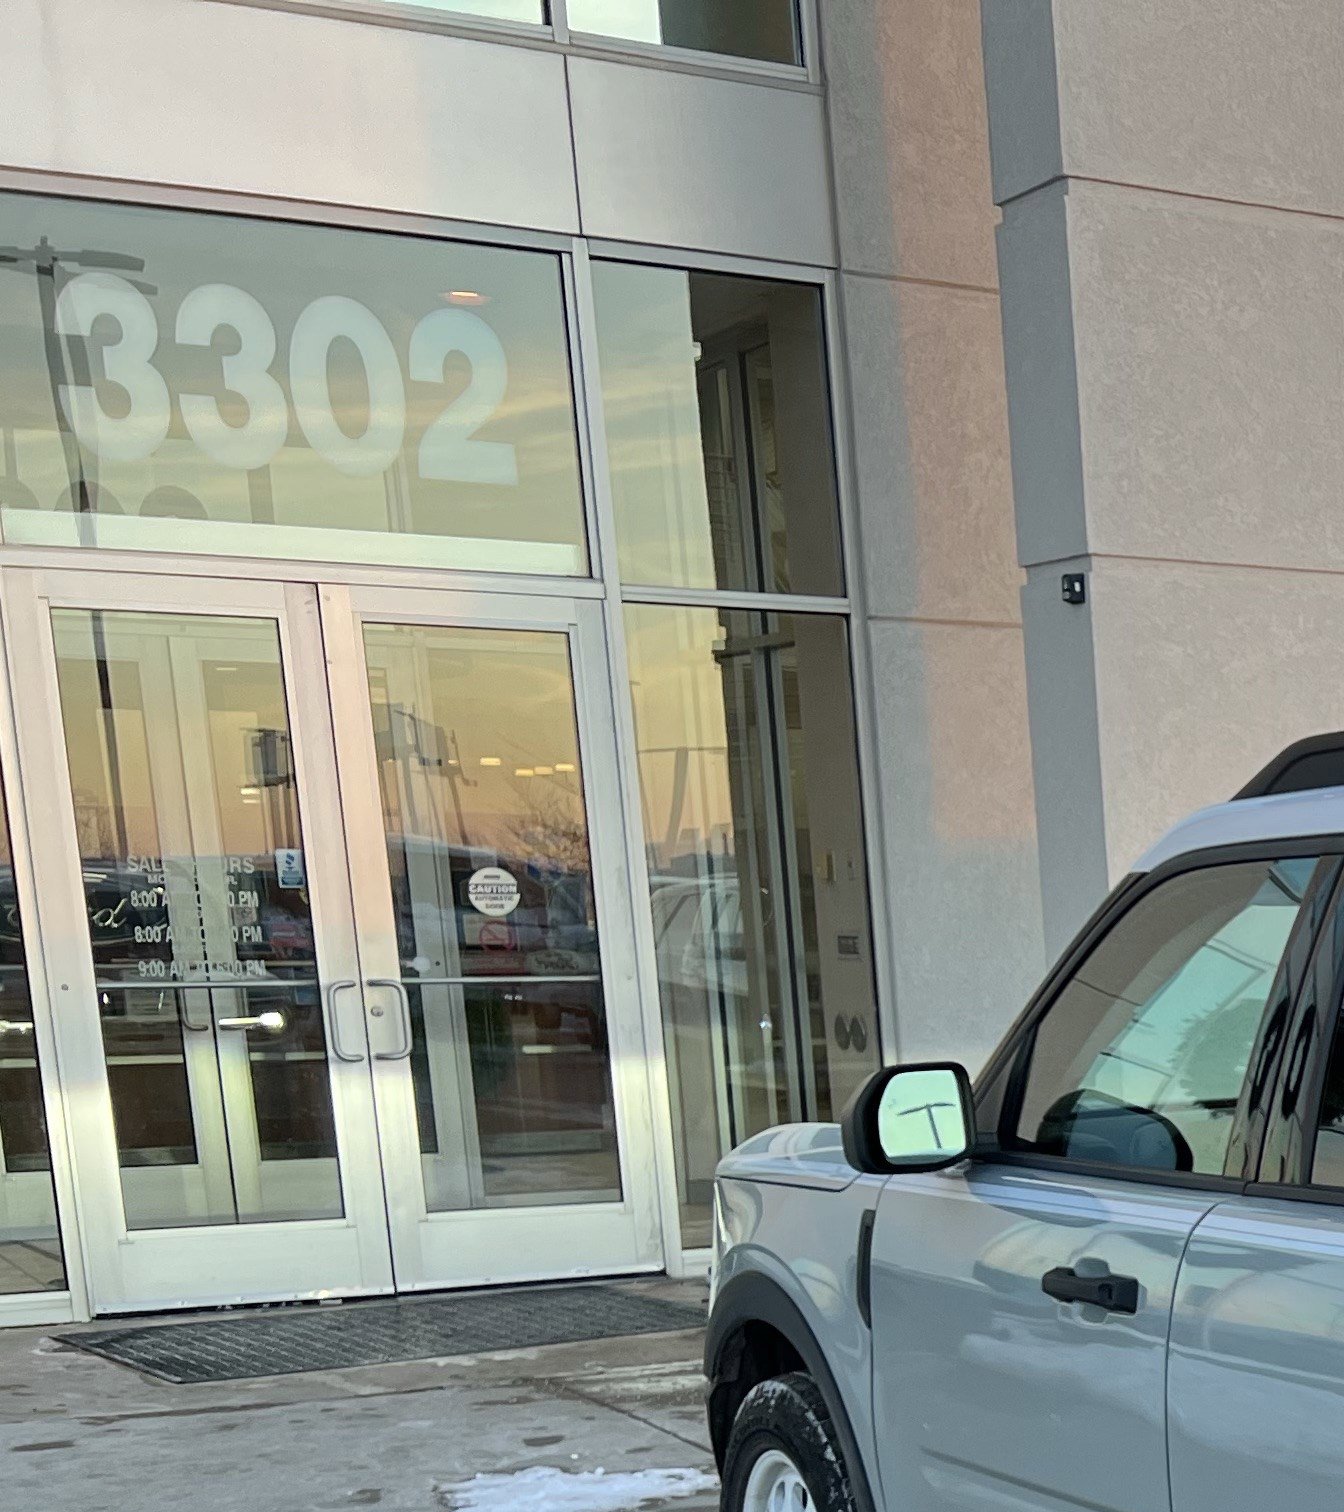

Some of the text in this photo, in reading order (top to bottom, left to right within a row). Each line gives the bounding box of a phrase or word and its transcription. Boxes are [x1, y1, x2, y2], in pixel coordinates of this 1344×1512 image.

[55, 271, 518, 485] 3302
[469, 884, 517, 894] CAUTION
[130, 890, 158, 907] 8:00
[238, 890, 259, 908] PM
[134, 925, 162, 943] 8:00
[242, 926, 263, 943] PM
[138, 960, 165, 978] 9:00
[246, 959, 267, 977] PM
